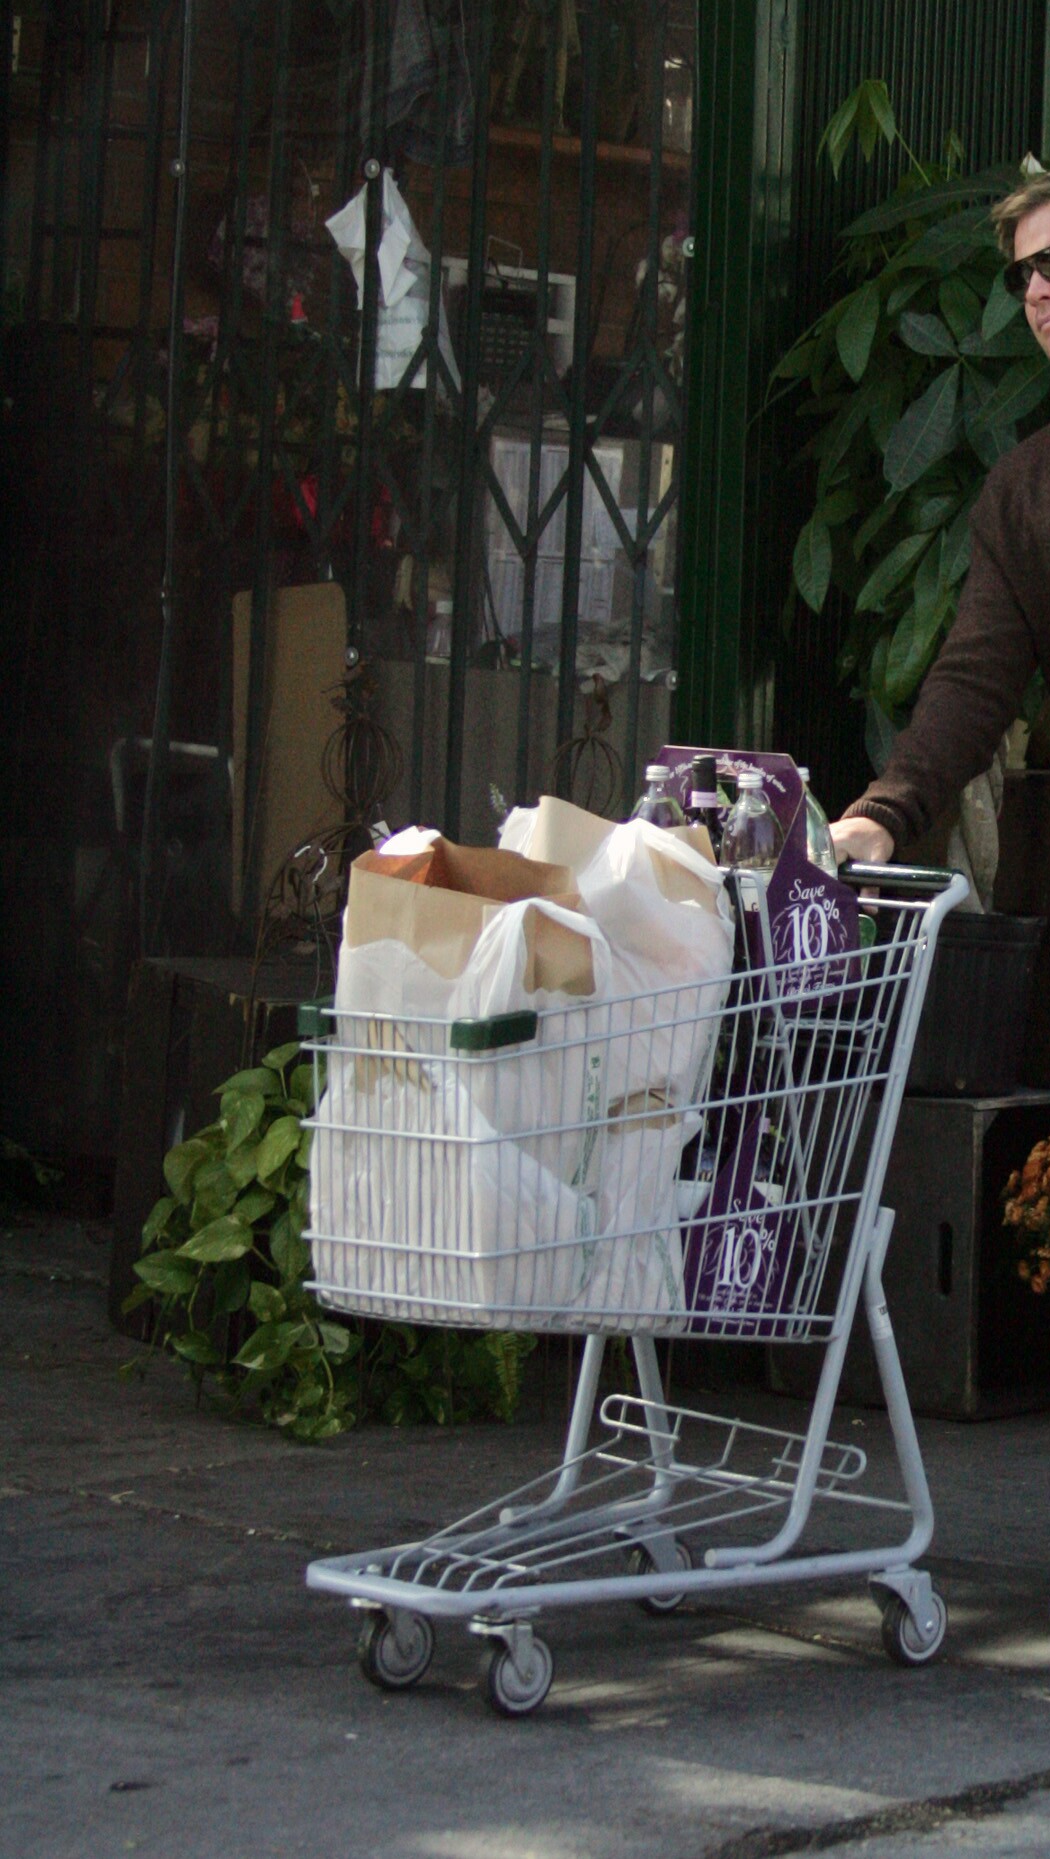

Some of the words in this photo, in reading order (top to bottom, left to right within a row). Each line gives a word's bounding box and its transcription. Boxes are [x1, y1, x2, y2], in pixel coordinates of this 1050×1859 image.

[789, 879, 826, 904] Save
[787, 899, 840, 963] 10%
[718, 1227, 776, 1288] 10%
